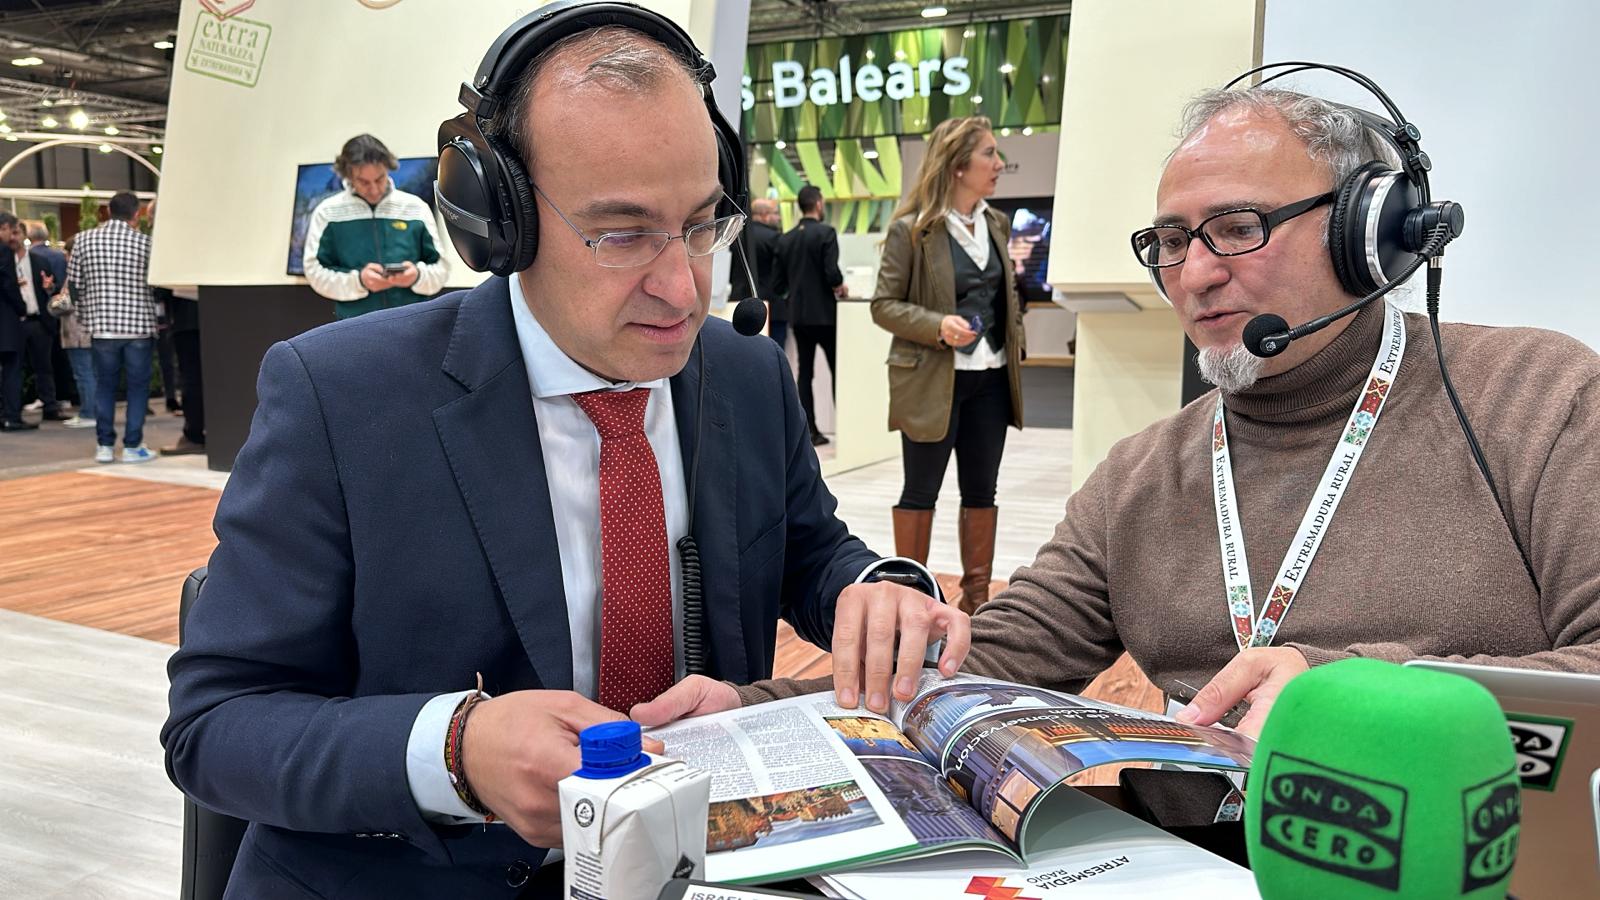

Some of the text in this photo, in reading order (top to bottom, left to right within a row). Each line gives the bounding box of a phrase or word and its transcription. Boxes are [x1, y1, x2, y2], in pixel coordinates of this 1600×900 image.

[202, 21, 259, 48] extra
[772, 54, 972, 108] Balears
[1215, 455, 1238, 581] EXTREMADURA RURAL
[1284, 451, 1356, 583] EXTREMADURA RURAL
[1279, 778, 1379, 823] ONDA
[1279, 817, 1377, 866] CERO
[1026, 868, 1068, 884] RADIO
[1036, 855, 1130, 890] ATRESMEDIA
